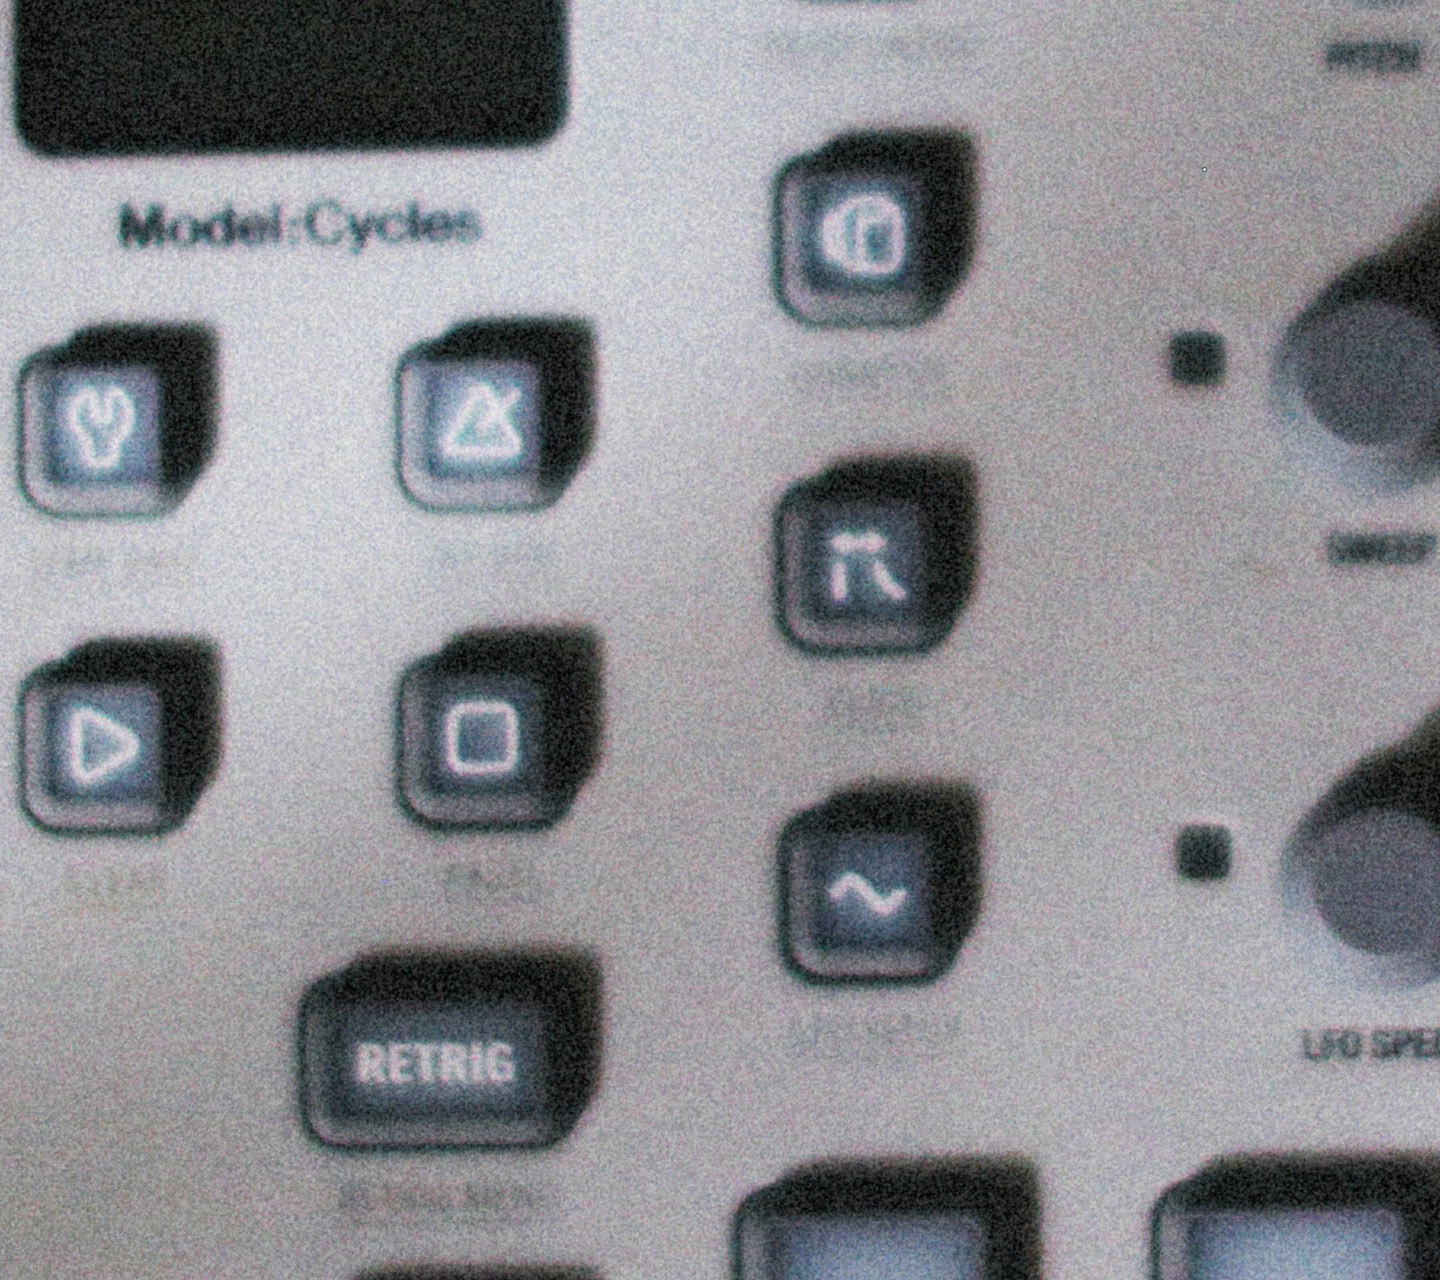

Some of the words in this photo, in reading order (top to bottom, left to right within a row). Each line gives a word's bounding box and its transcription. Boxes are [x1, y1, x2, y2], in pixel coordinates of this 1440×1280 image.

[117, 204, 478, 252] Model:Cycles
[355, 1041, 515, 1087] RETRIG
[1301, 1028, 1363, 1064] LFO
